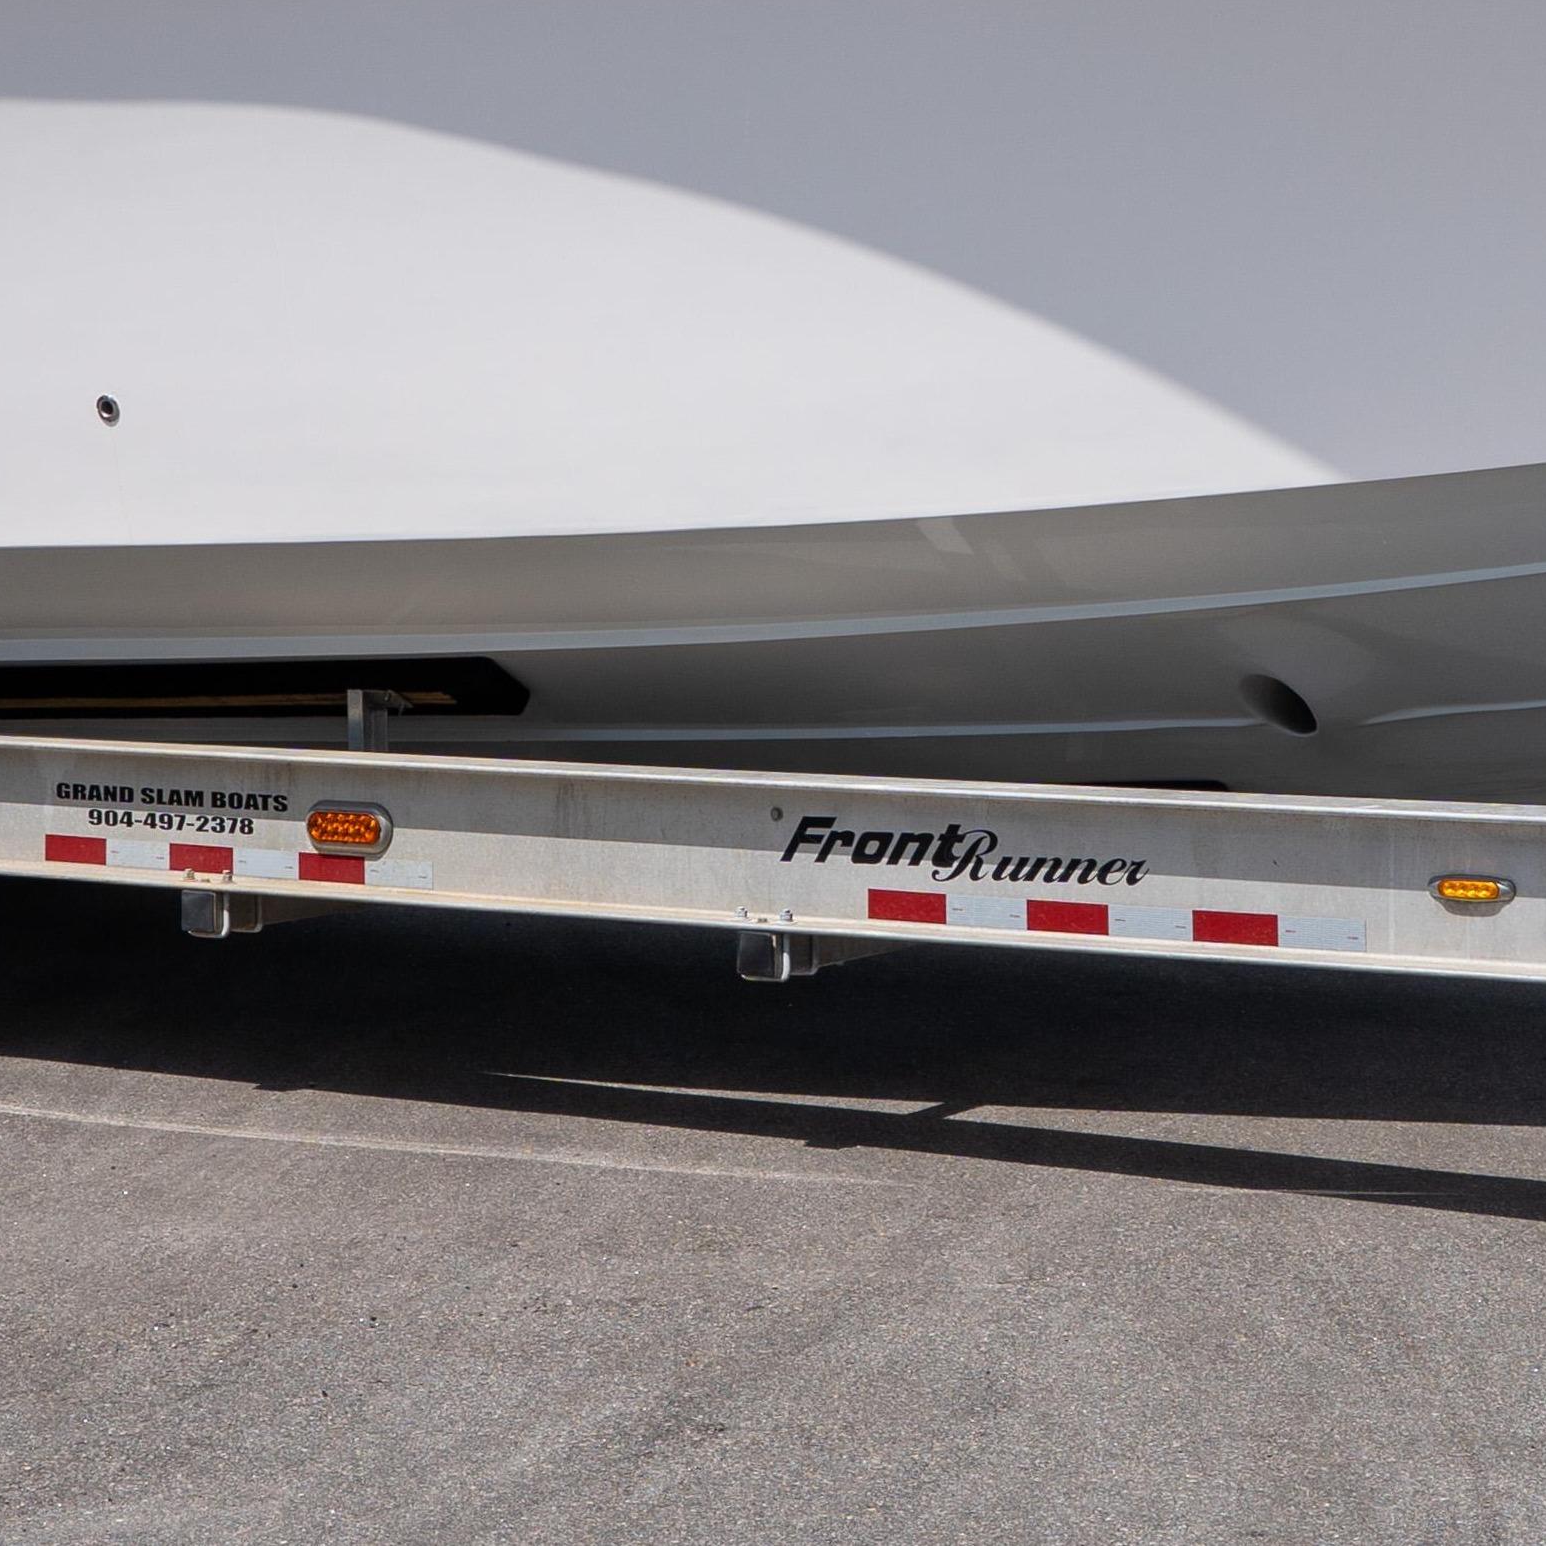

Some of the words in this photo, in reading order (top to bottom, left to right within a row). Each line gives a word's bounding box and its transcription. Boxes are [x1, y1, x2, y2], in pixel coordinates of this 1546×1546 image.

[56, 782, 134, 803] GRAND
[141, 787, 204, 807] SLAM
[211, 791, 288, 812] BOATS
[88, 809, 254, 835] 904-497-2378
